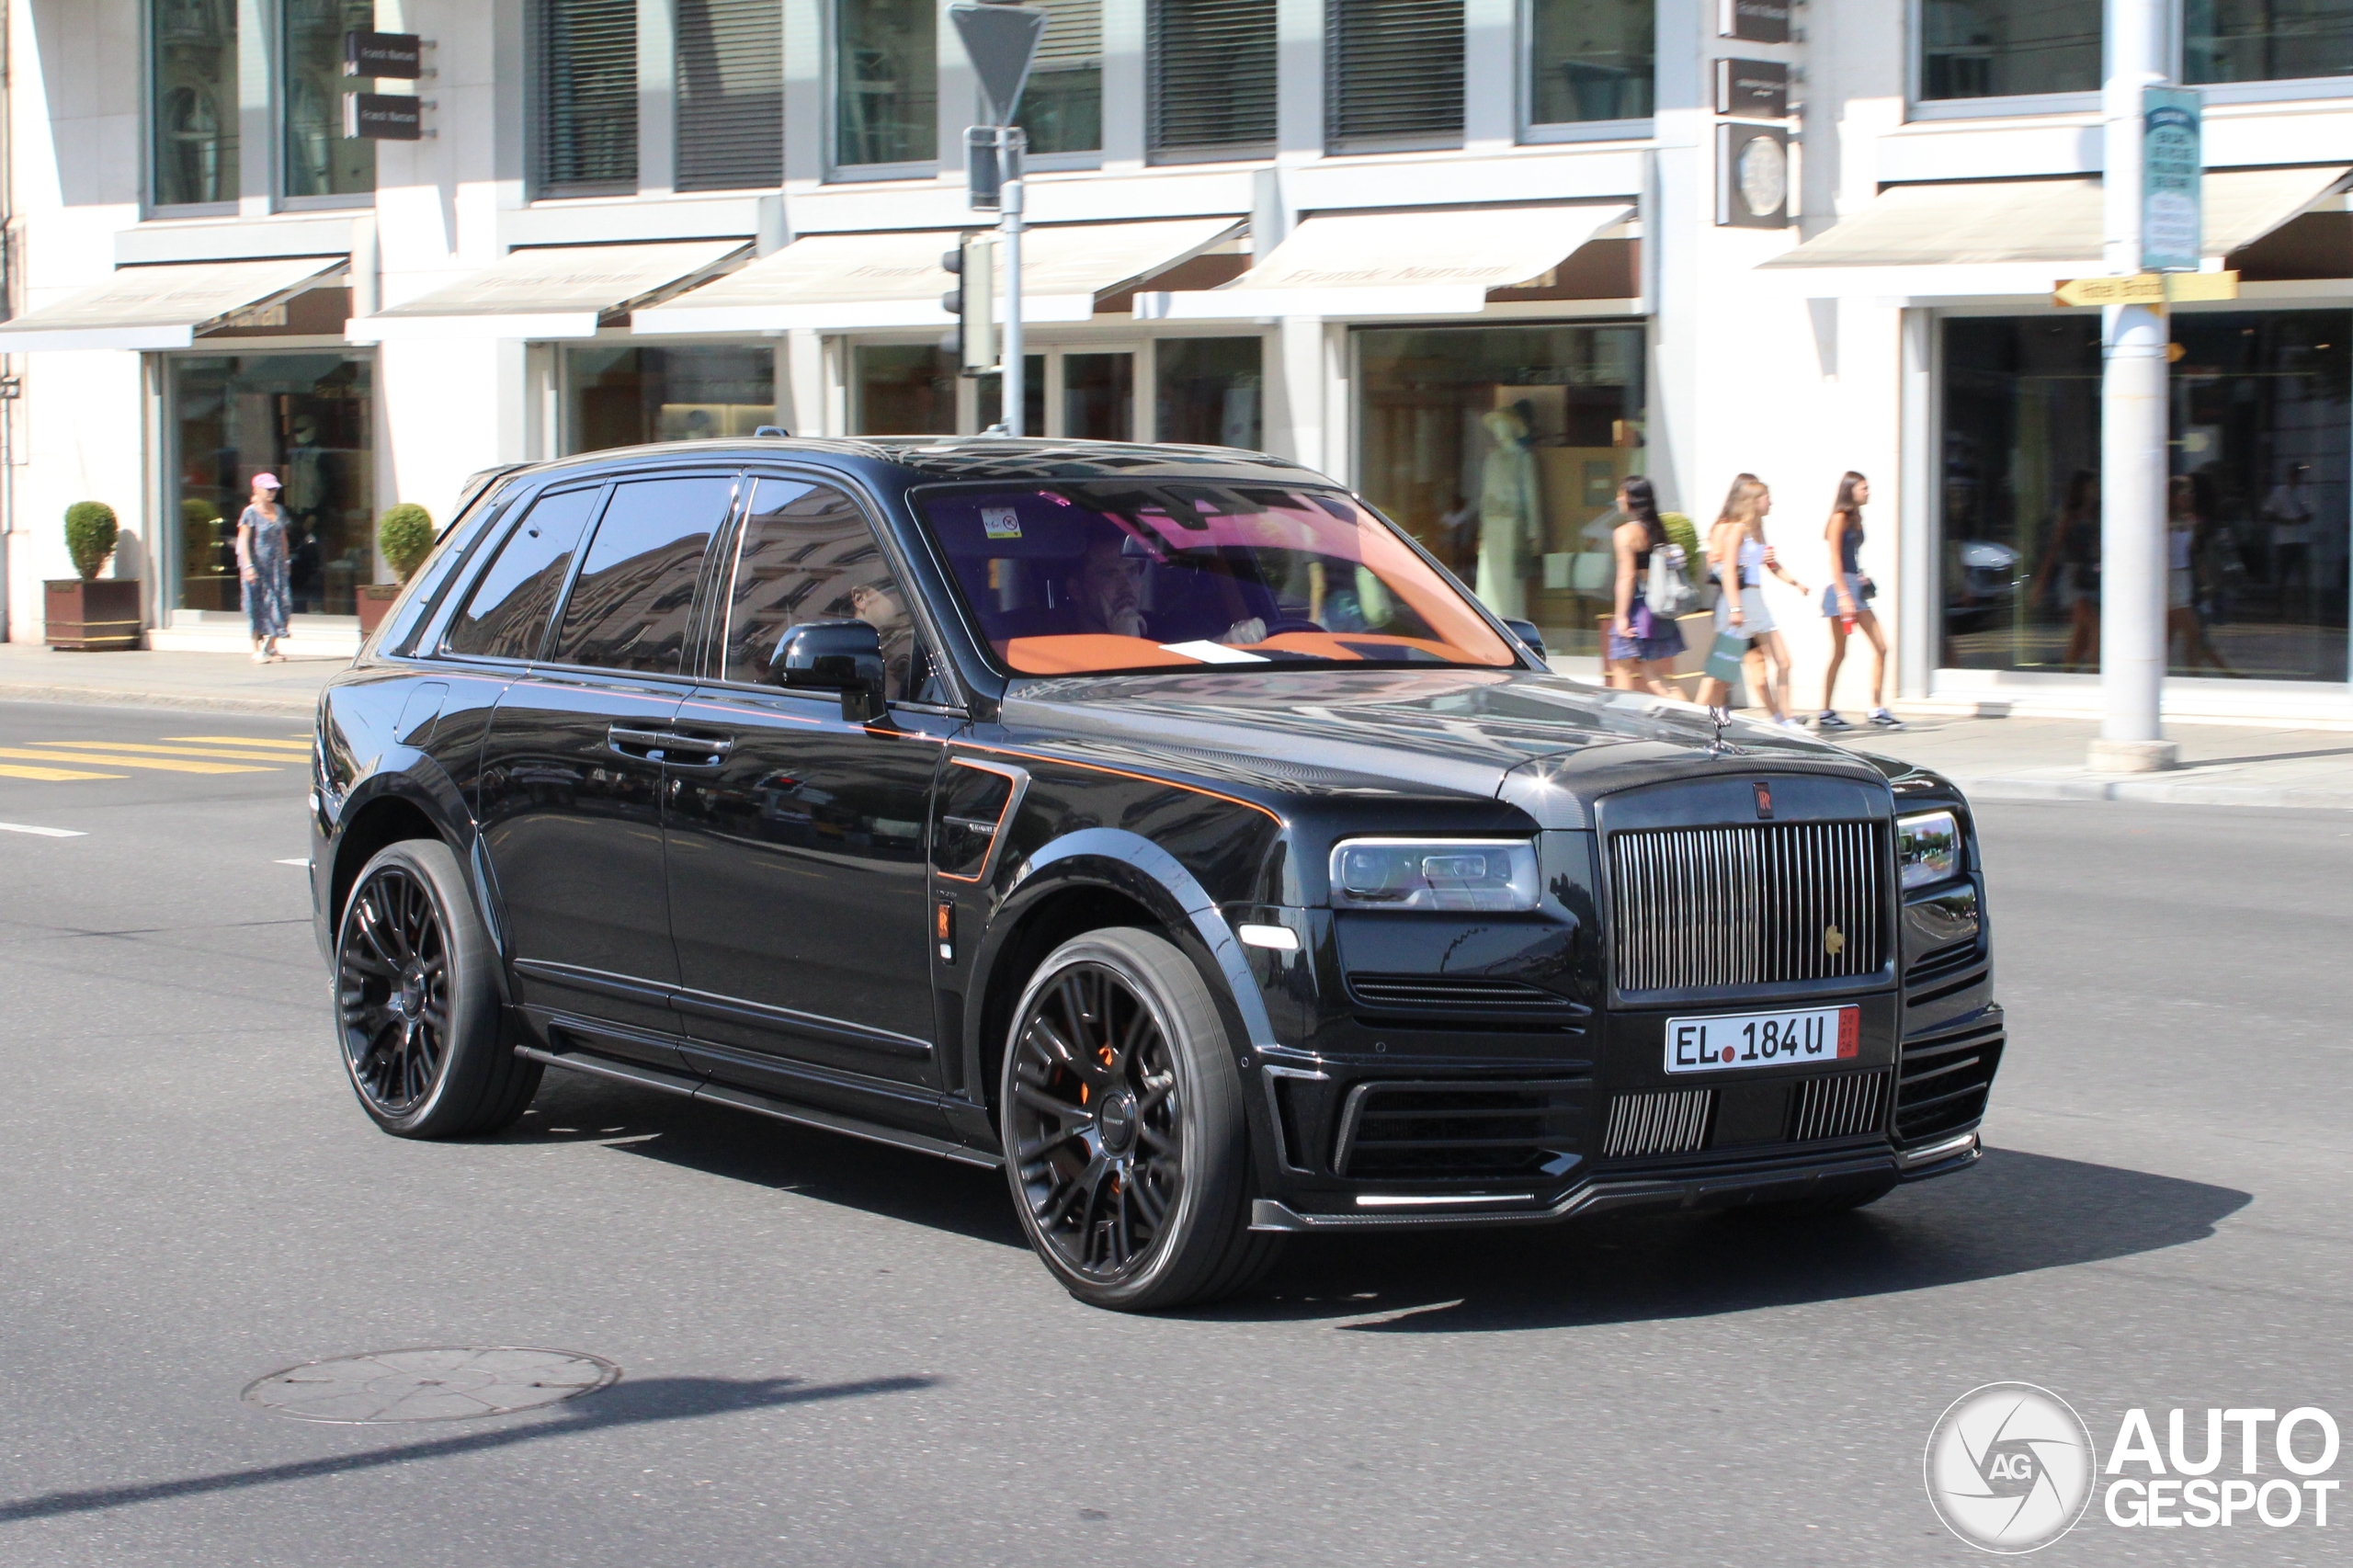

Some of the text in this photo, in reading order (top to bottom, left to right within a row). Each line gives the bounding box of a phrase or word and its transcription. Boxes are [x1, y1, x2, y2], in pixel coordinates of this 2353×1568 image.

[1281, 267, 1388, 282] Franck
[1391, 264, 1512, 280] Namani
[1677, 1026, 1719, 1065] EL
